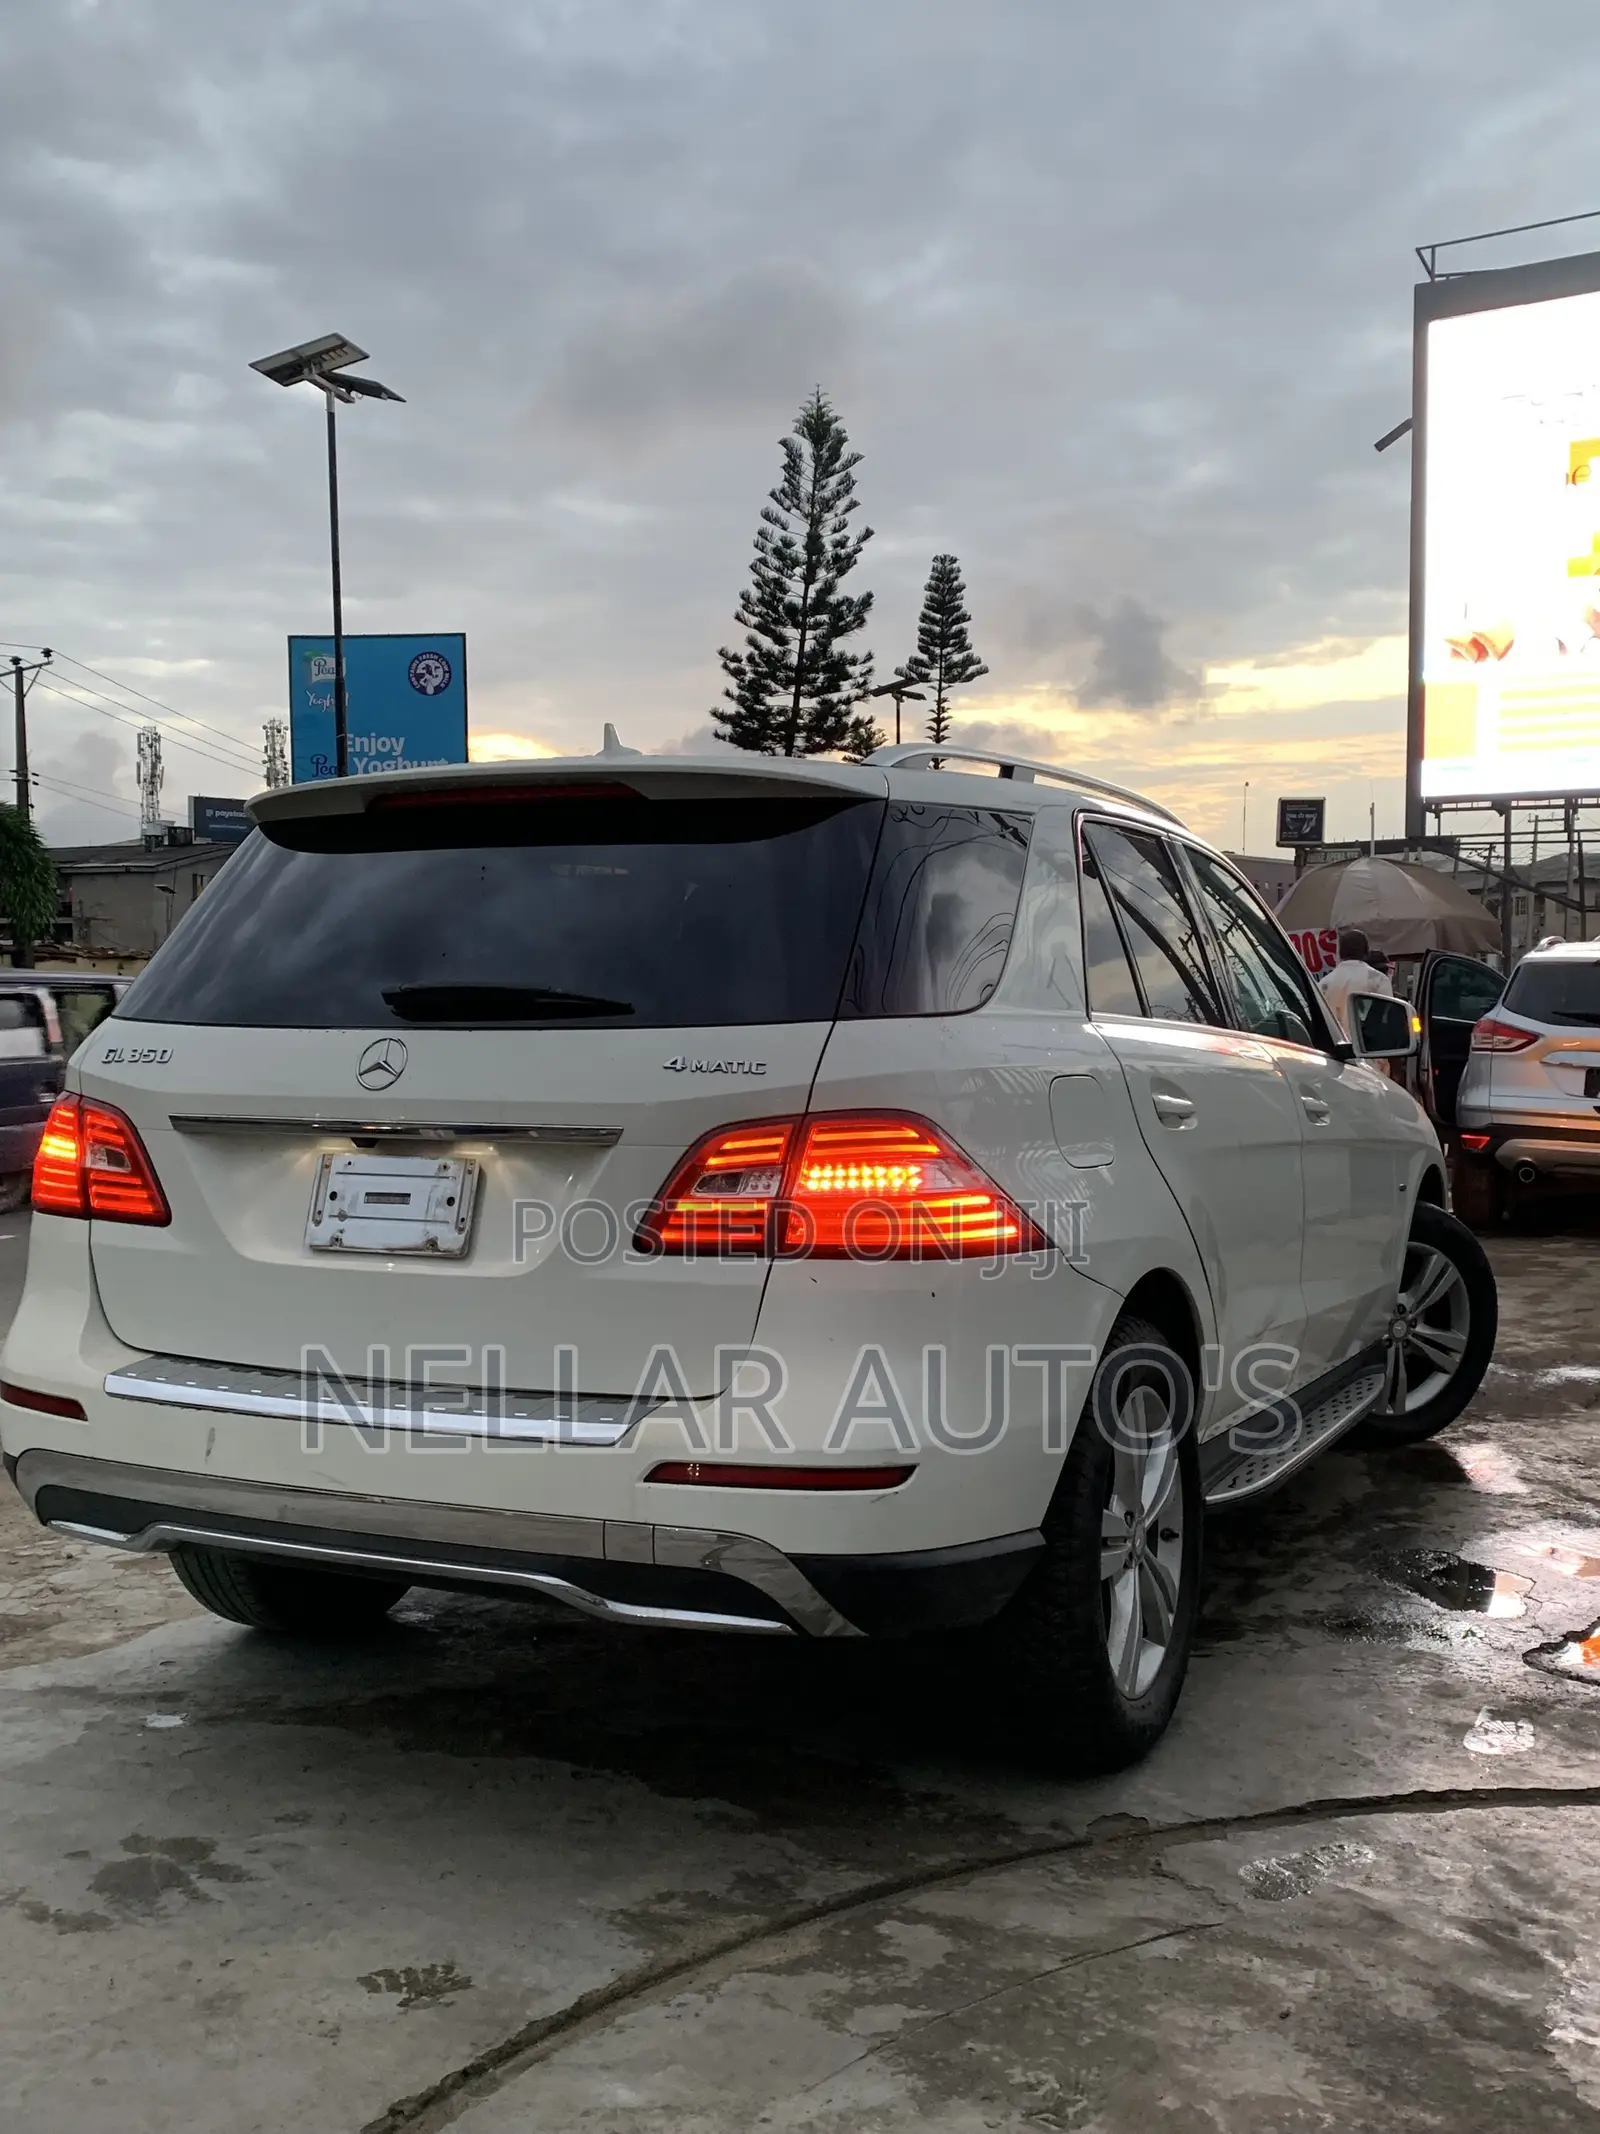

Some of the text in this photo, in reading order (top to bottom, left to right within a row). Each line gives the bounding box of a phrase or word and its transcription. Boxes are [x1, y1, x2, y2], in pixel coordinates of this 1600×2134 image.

[313, 657, 337, 677] Pea
[305, 690, 349, 713] Yoght
[347, 732, 405, 756] Enjoy
[310, 753, 337, 779] Pea
[215, 810, 248, 819] paystac
